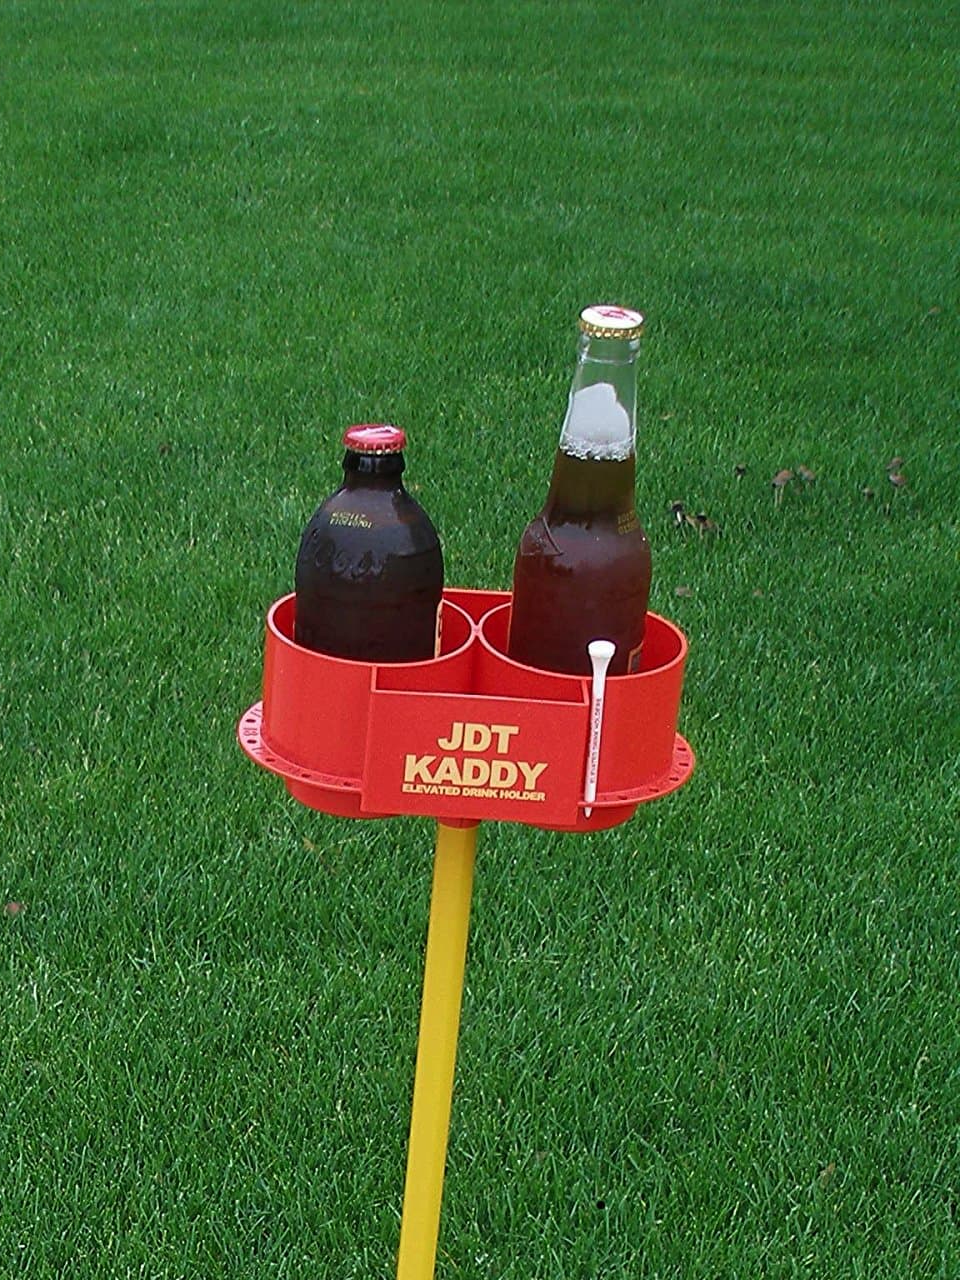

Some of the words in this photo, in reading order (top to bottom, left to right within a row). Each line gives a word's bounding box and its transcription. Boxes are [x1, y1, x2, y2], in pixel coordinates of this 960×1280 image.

[437, 722, 520, 754] JDT
[403, 754, 549, 790] KADDY
[401, 783, 461, 796] ELEVATED
[462, 787, 498, 798] DRINK
[499, 790, 546, 802] HOLDER
